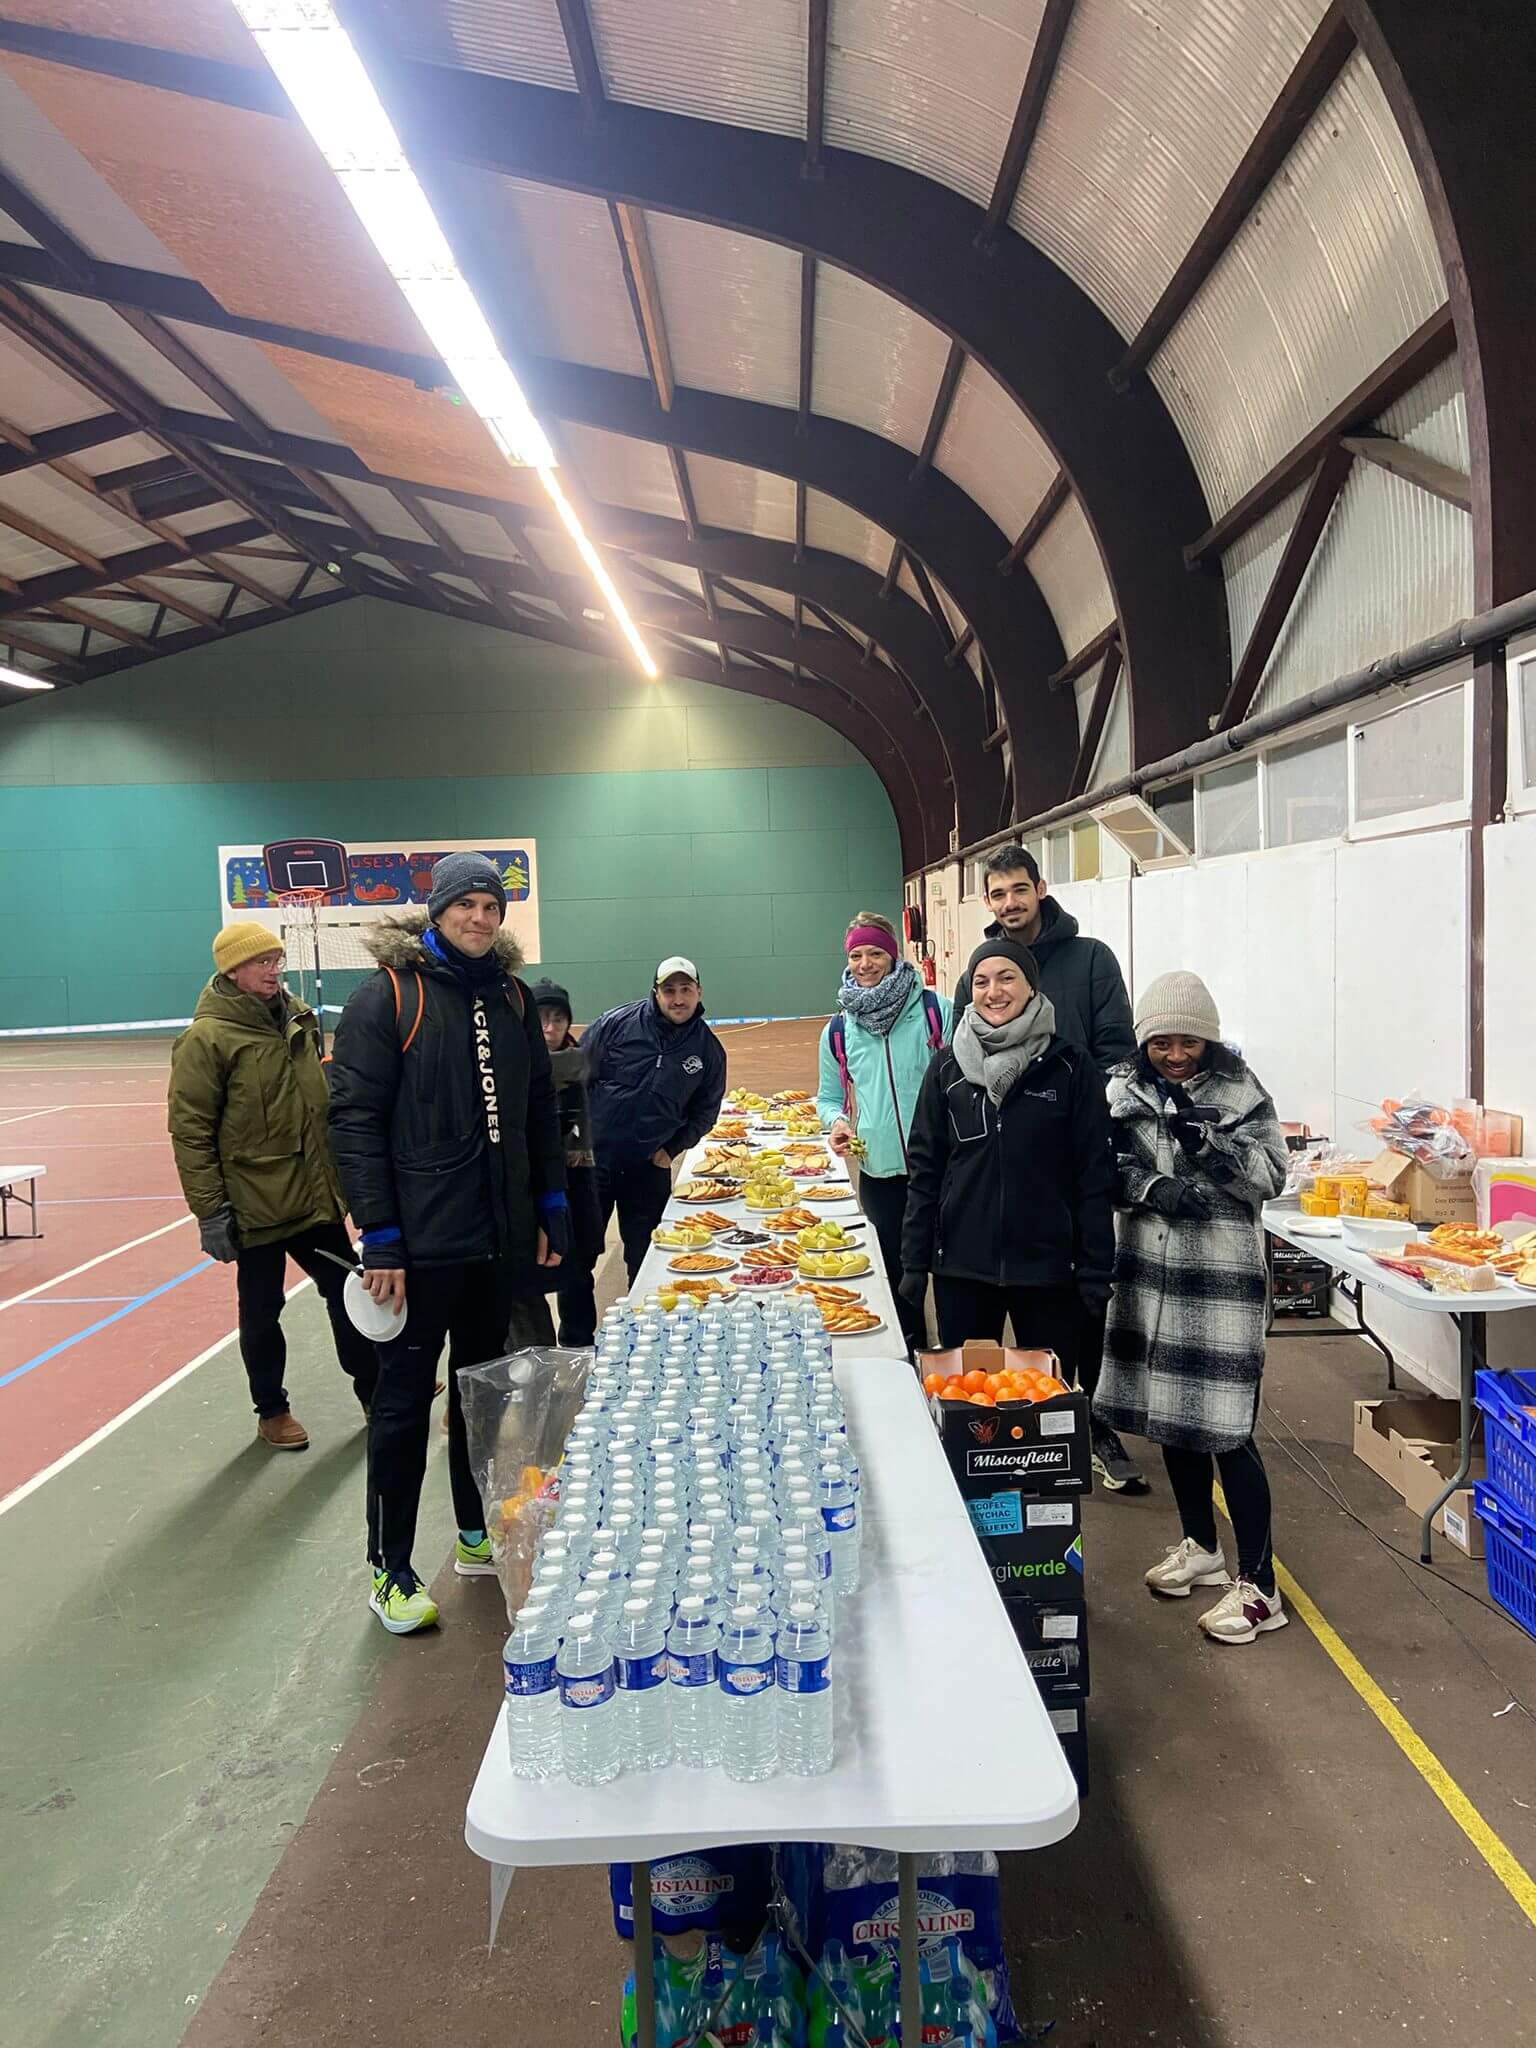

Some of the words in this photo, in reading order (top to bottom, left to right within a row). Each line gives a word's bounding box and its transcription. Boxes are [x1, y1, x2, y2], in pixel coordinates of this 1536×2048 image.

[473, 996, 501, 1144] ACK&JONES
[974, 1450, 1064, 1468] Mistouflette
[856, 1912, 972, 1940] CRISALINE
